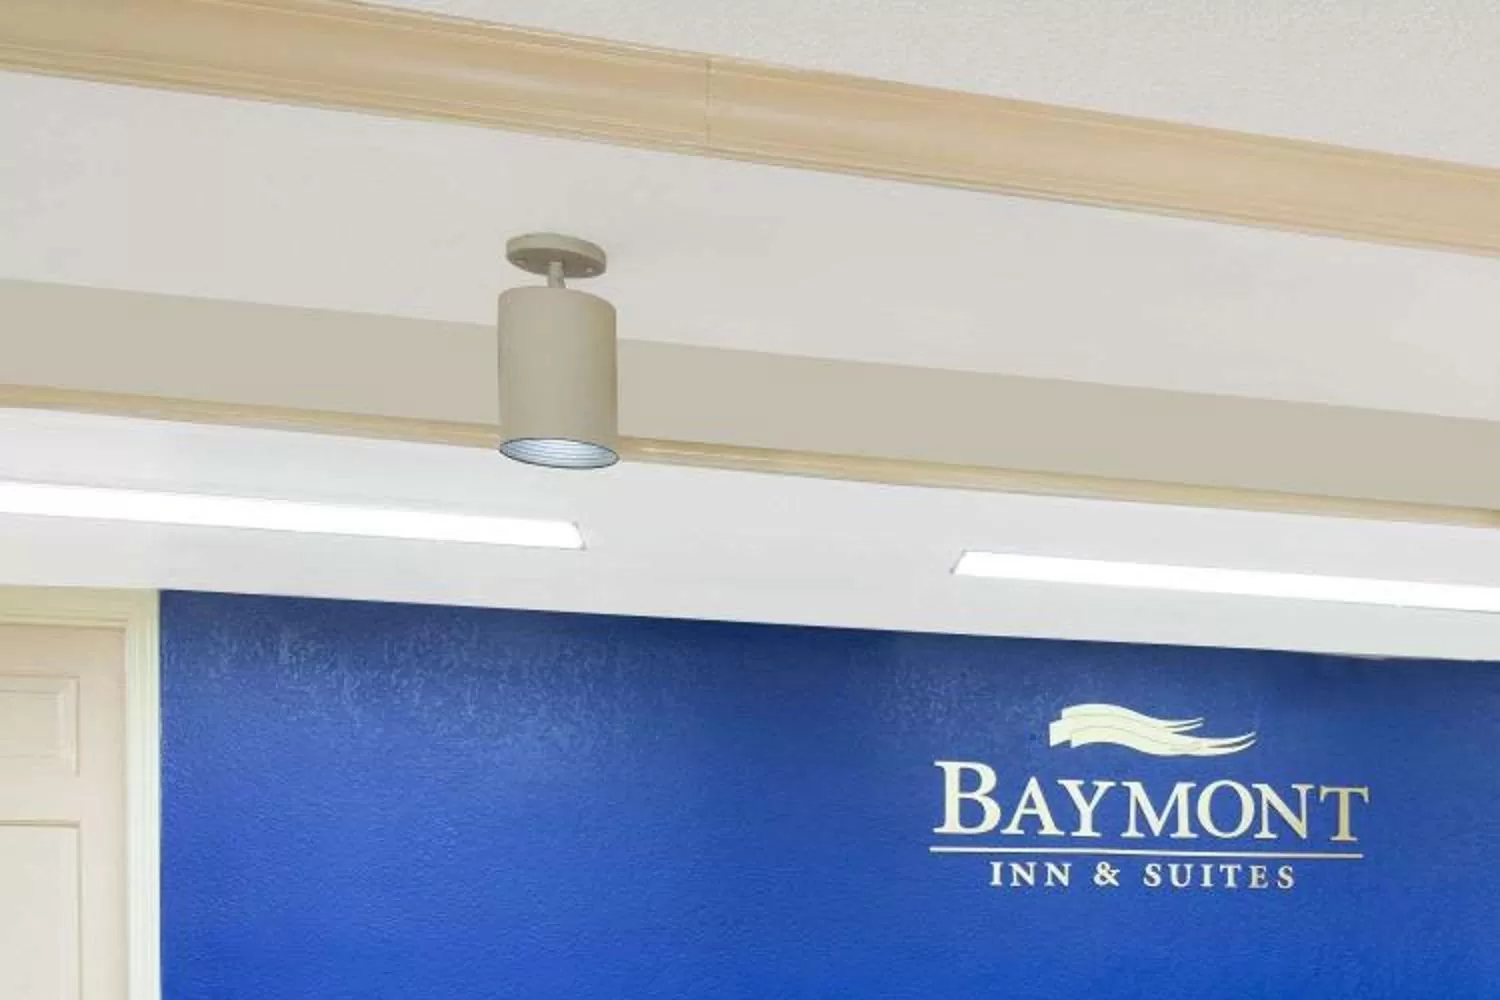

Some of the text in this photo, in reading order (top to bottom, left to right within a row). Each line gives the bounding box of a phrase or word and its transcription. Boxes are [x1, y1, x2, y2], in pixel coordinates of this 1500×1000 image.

[932, 760, 1369, 841] BAYMONT
[990, 861, 1295, 888] INN & SUITES
